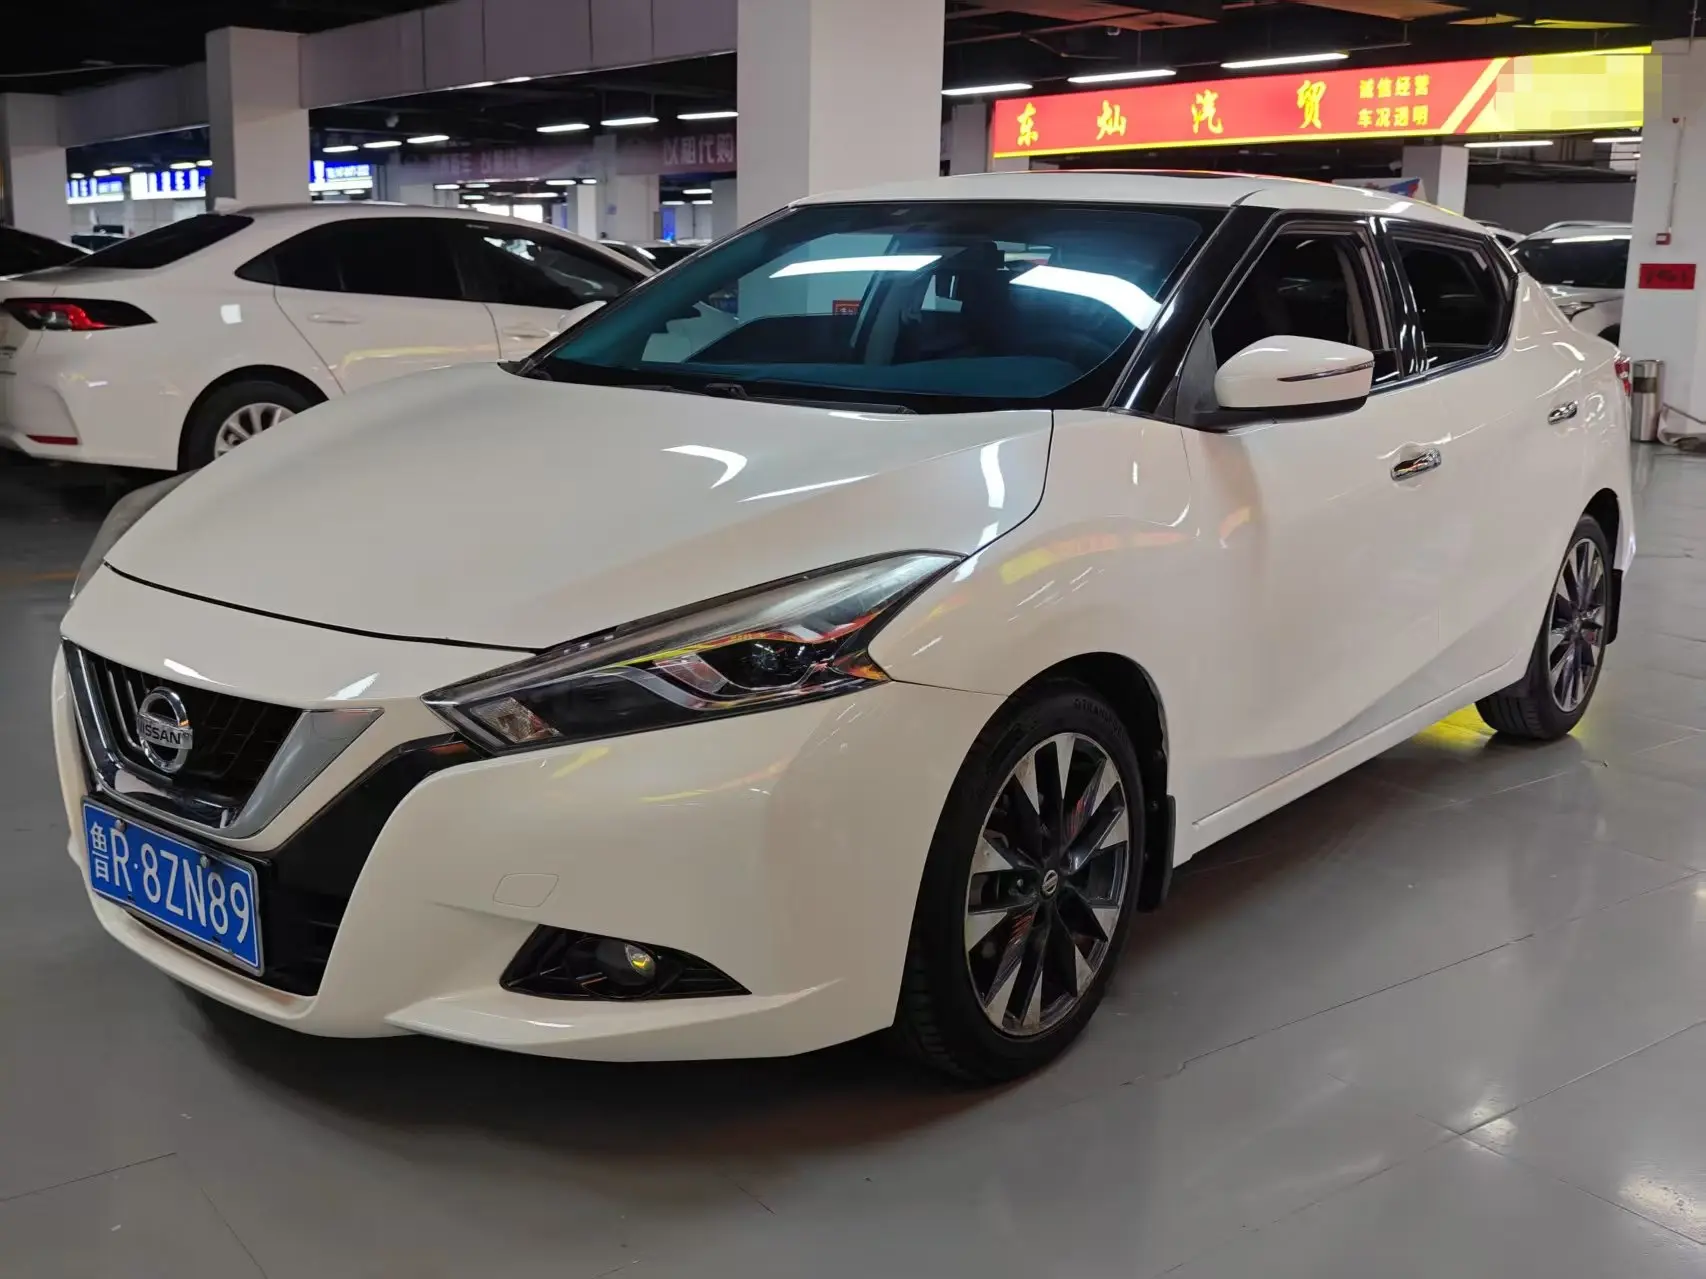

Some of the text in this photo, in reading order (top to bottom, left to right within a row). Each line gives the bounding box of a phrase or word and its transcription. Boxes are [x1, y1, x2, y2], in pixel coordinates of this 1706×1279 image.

[1359, 74, 1431, 99] 诚信经营
[1016, 79, 1328, 147] 东灿汽贸
[1357, 104, 1430, 129] 车况透明
[137, 716, 182, 746] NISSAN
